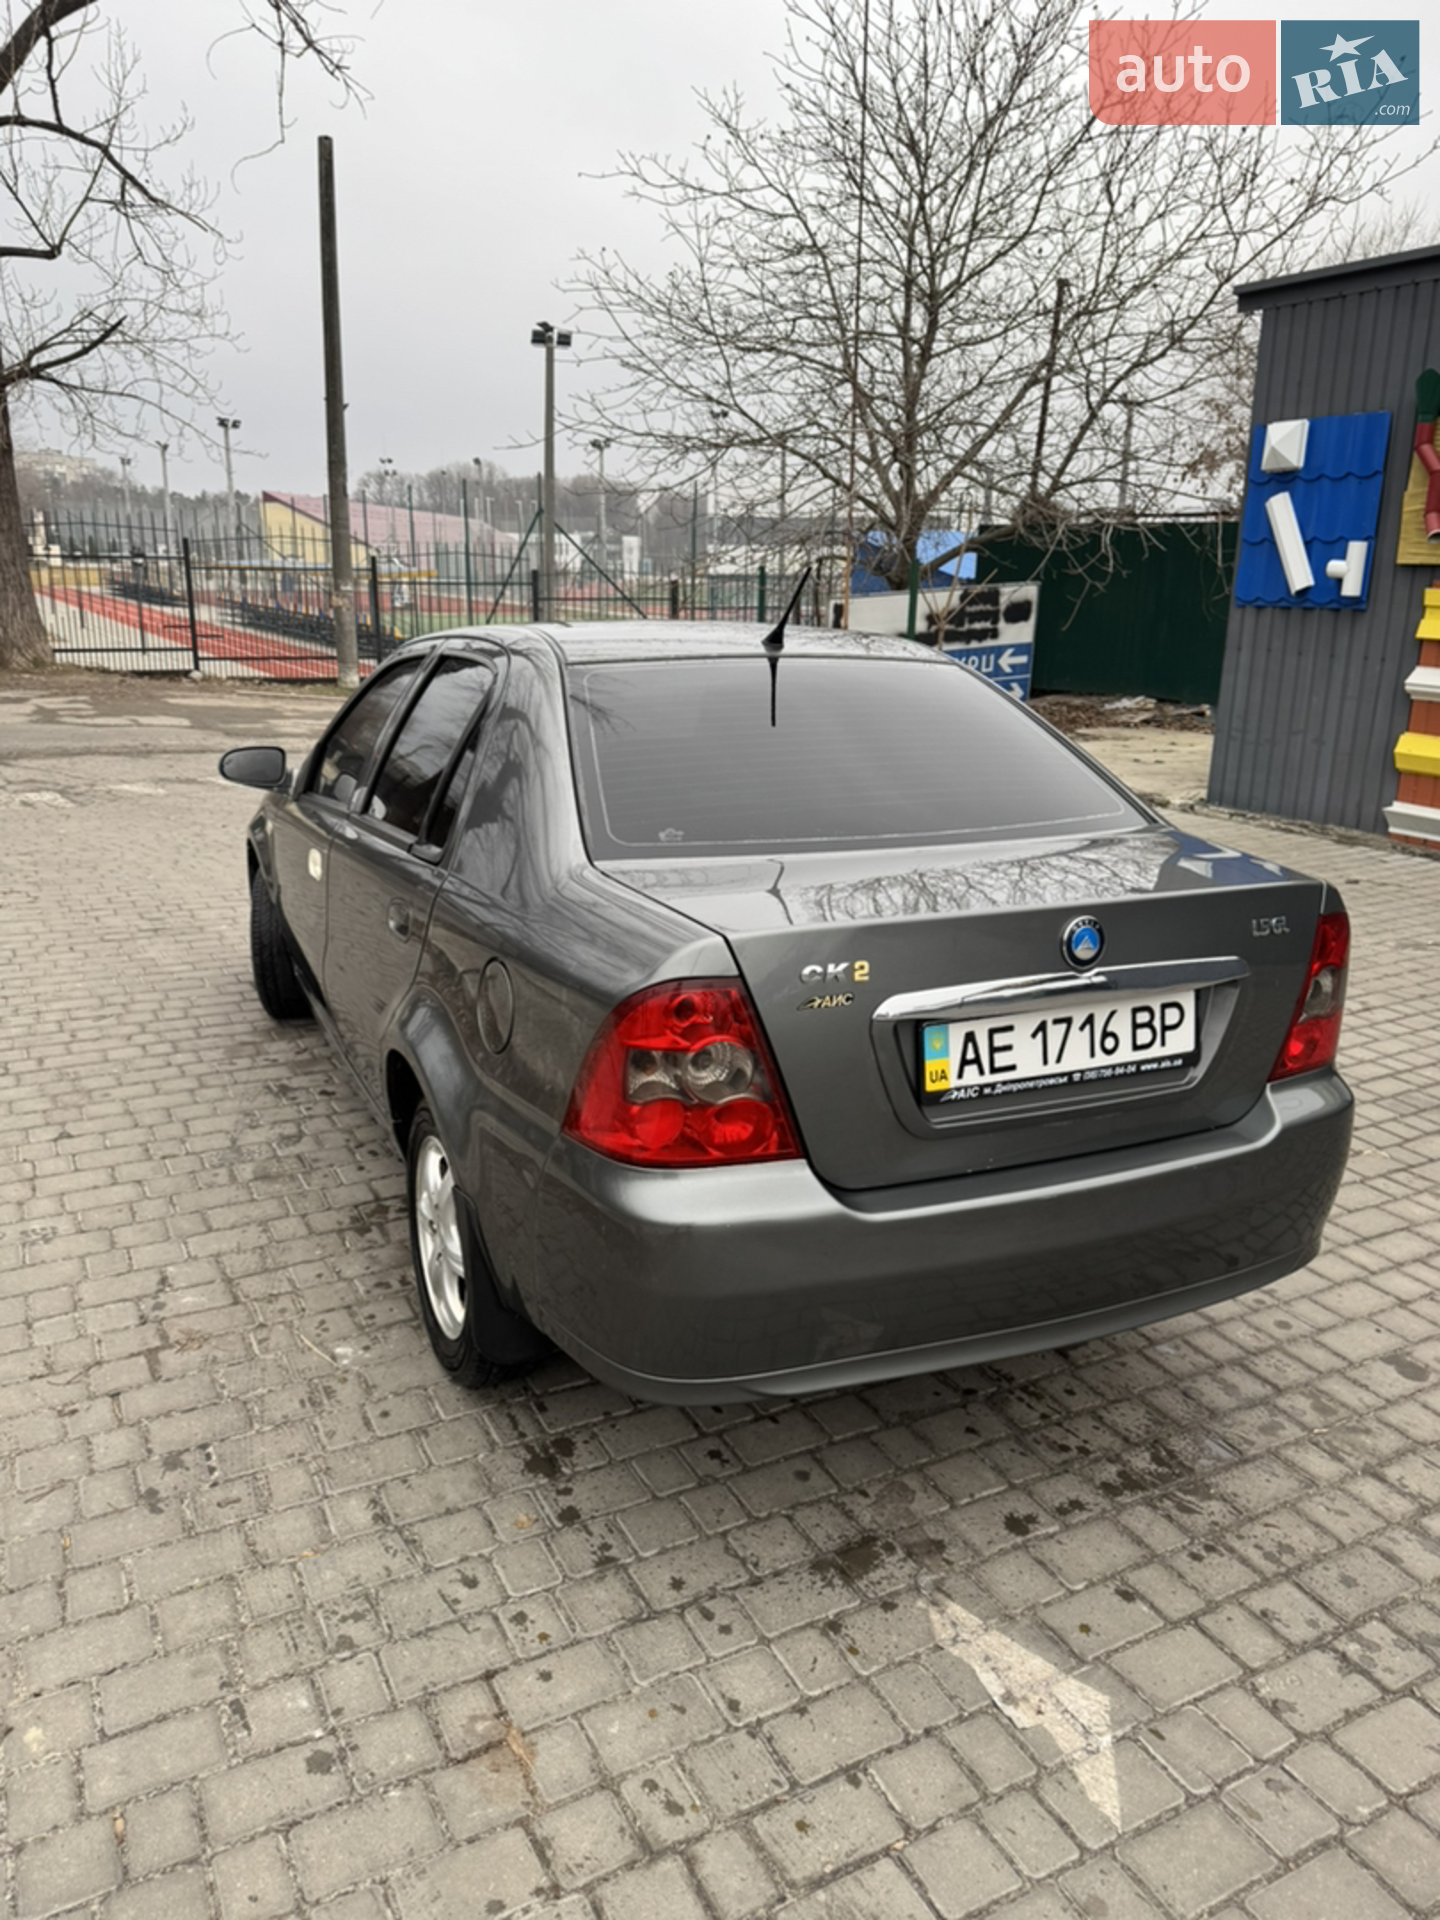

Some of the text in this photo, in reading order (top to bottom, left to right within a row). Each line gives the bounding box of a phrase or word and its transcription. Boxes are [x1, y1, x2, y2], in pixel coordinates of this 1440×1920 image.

[957, 1001, 1186, 1081] AE 1716 BP
[929, 1068, 949, 1084] UA
